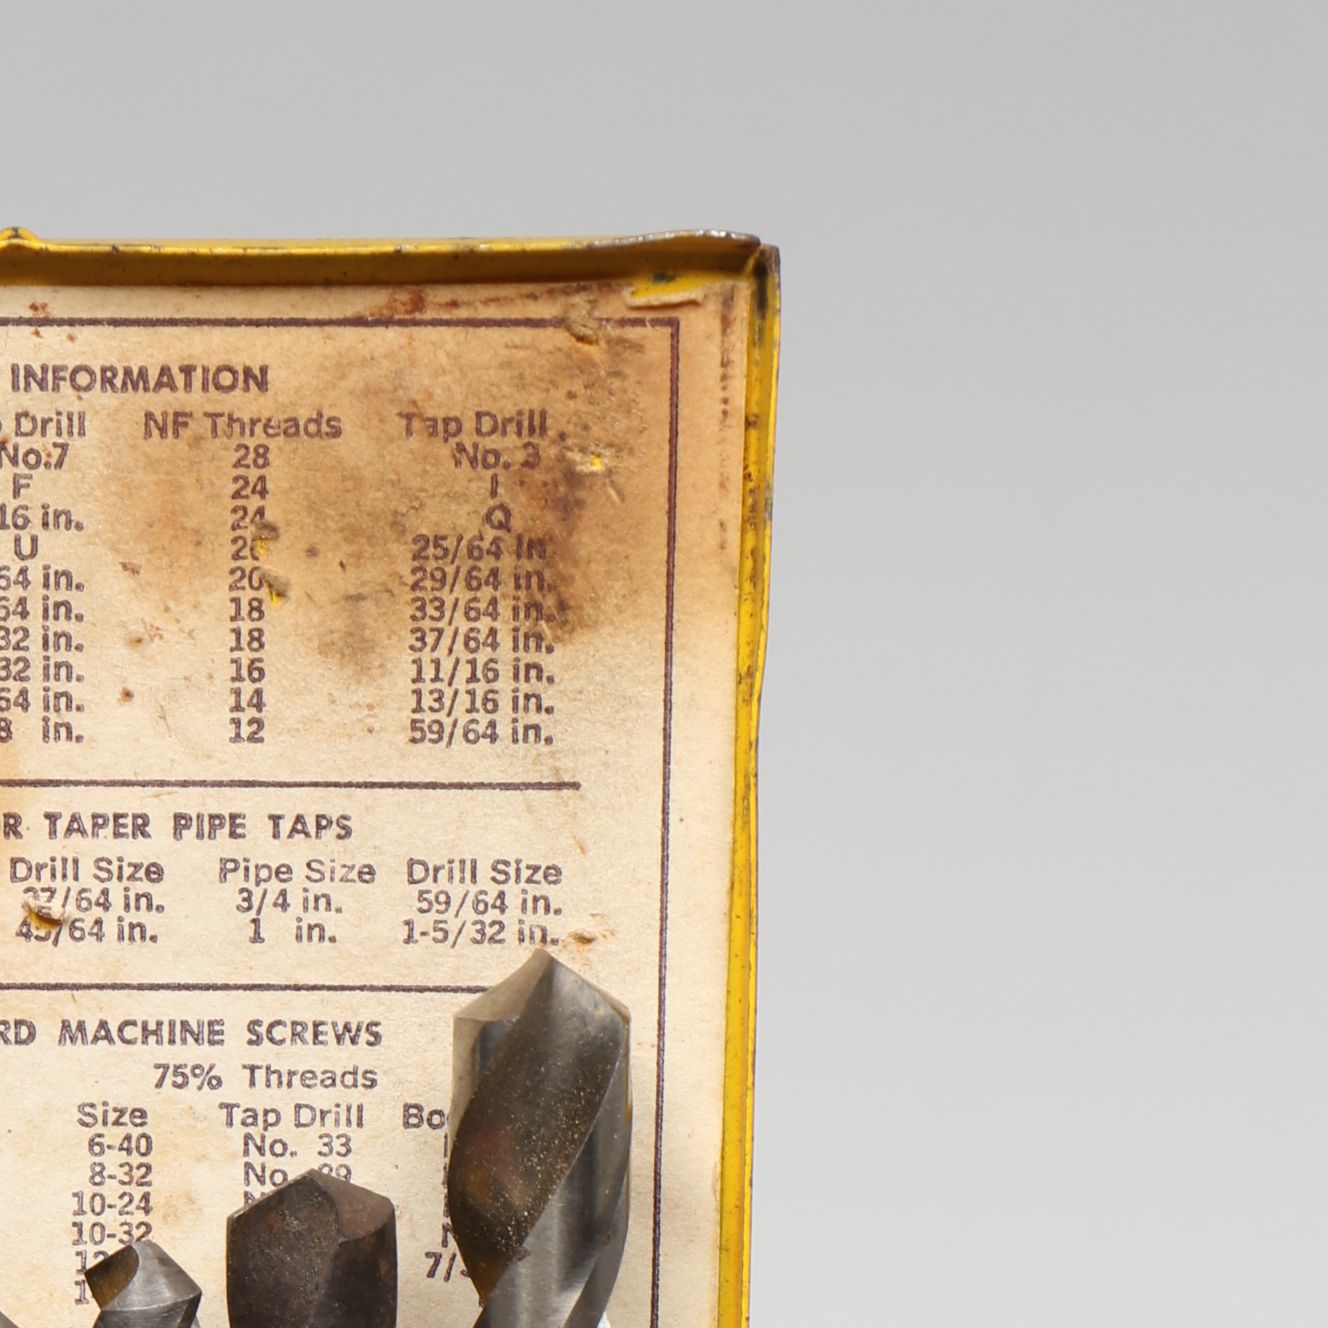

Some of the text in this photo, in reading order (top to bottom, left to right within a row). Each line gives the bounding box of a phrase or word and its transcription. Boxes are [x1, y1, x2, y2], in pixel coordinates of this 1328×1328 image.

[10, 362, 269, 394] INFORMATION
[14, 409, 86, 438] Drill
[143, 410, 194, 440] NF
[211, 409, 343, 439] Threads
[474, 409, 548, 438] Drill
[231, 443, 270, 470] 28
[12, 472, 34, 500] F
[230, 474, 270, 501] 24
[40, 503, 85, 532] in.
[484, 502, 512, 533] Q
[13, 533, 39, 562] U
[42, 564, 85, 593] in.
[229, 596, 266, 623] 18
[229, 656, 266, 684] 16
[410, 656, 555, 688] 11/16 in.
[228, 686, 267, 714] 14
[41, 715, 85, 744] in.
[228, 716, 265, 744] 12
[407, 717, 554, 749] 59/64 in.
[42, 810, 153, 841] TAPER
[172, 811, 247, 842] PIPE
[267, 813, 353, 841] TAPS
[9, 855, 80, 884] Drill
[92, 855, 165, 884] Size
[218, 856, 294, 888] Pipe
[304, 858, 377, 885] Size
[406, 857, 478, 886] Drill
[489, 858, 563, 886] Size
[235, 886, 343, 917] 3/4 in.
[416, 888, 563, 919] 59/64 in.
[402, 918, 560, 949] 1-5/32 in.
[57, 1018, 225, 1047] MACHINE
[245, 1018, 383, 1048] SCREWS
[153, 1062, 378, 1092] 75% Threads
[76, 1100, 365, 1133] Size Tap Drill
[87, 1131, 154, 1158] 6-40
[242, 1131, 353, 1159] No. 33
[71, 1220, 153, 1247] 10-32
